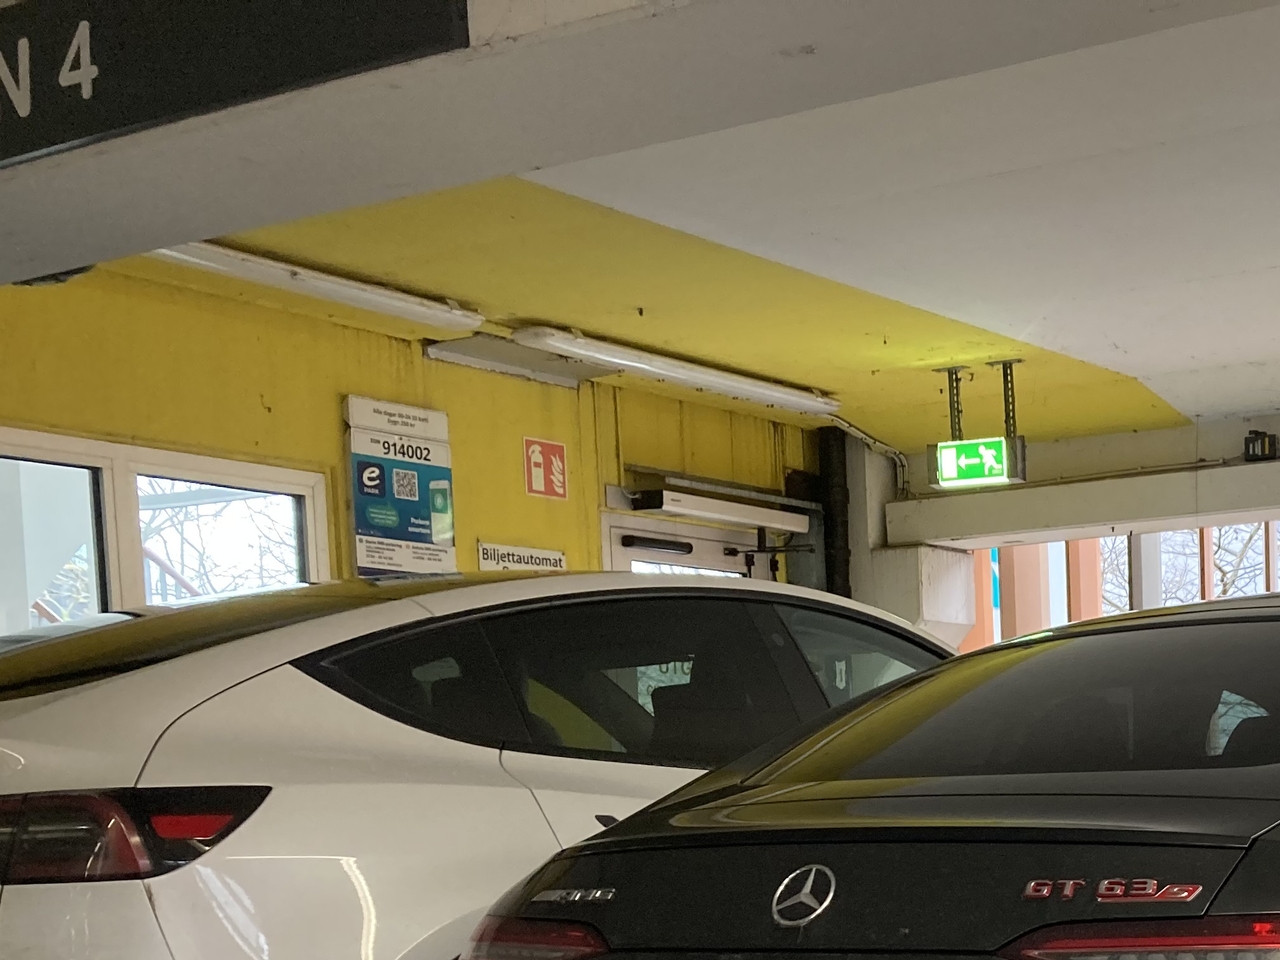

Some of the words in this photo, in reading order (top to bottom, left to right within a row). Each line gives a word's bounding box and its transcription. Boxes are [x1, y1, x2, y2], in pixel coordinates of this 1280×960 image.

[58, 20, 99, 100] 4
[382, 440, 432, 462] 914002
[362, 466, 380, 487] e
[482, 547, 564, 569] Biljettautomat
[1022, 878, 1086, 900] GT
